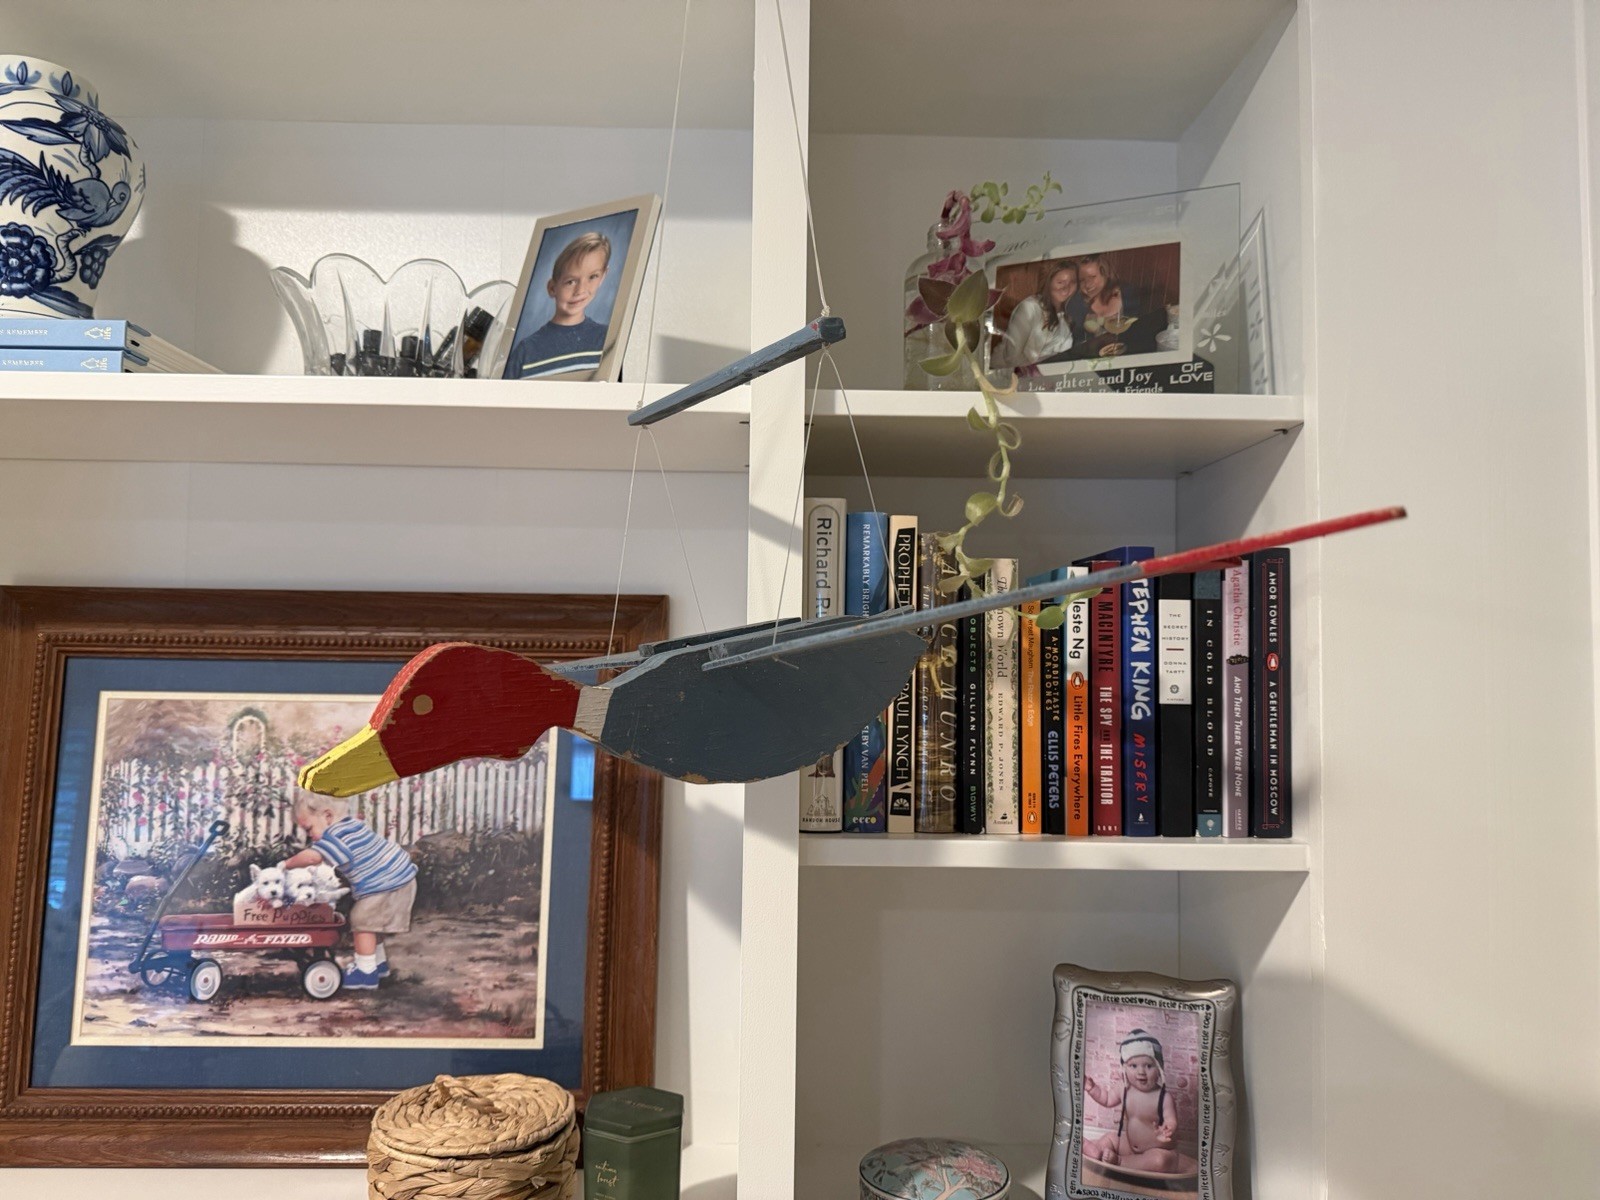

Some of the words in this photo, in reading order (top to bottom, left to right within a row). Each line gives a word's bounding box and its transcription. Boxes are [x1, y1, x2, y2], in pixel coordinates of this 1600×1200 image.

[1098, 369, 1124, 387] and
[1128, 368, 1153, 386] Joy
[1170, 372, 1213, 384] LOVE
[1181, 362, 1204, 373] OF
[815, 517, 832, 589] Richard
[862, 523, 871, 588] REMARKABLY
[1230, 568, 1243, 604] Agatha
[1268, 571, 1278, 600] AMOR
[862, 588, 870, 618] BRIGH
[1072, 601, 1085, 633] leste
[1128, 577, 1152, 653] TEPHEN
[1206, 609, 1213, 627] IN
[997, 607, 1005, 639] nown
[1027, 604, 1035, 636] Soerset
[1232, 606, 1244, 646] Christie
[1268, 604, 1278, 643] TOWLES
[969, 617, 977, 673] OBJECTS
[1068, 638, 1084, 659] Ng
[1098, 601, 1114, 672] MACINTYRE
[1026, 637, 1035, 669] Maugham
[1100, 686, 1112, 703] THE
[1130, 661, 1152, 721] KING
[1233, 675, 1242, 695] AND
[969, 683, 977, 731] GILLIAN
[1073, 695, 1084, 721] Little
[1100, 707, 1112, 726] SPY
[1233, 696, 1243, 718] THEN
[1268, 691, 1278, 750] GENTLEMAN
[861, 725, 870, 748] LBY
[940, 679, 957, 802] MUNRO
[1048, 730, 1059, 761] ELLIS
[1073, 725, 1083, 751] Fires
[1233, 719, 1243, 746] THERE
[861, 749, 869, 769] VAN
[895, 725, 910, 780] LYNCH
[969, 738, 977, 776] FLYNN
[1100, 744, 1113, 760] THE
[1234, 747, 1243, 771] WERE
[1269, 754, 1278, 765] IN
[861, 773, 869, 793] PELT
[1133, 733, 1149, 803] MISERY
[1048, 763, 1060, 809] PETERS
[1071, 754, 1084, 820] Everywhere
[1100, 765, 1114, 805] TRAITOR
[1234, 773, 1243, 797] NONE
[1269, 769, 1278, 816] MOSCOW
[243, 907, 268, 922] Free
[272, 907, 326, 925] Puppies
[261, 933, 312, 945] FLYER
[1089, 993, 1102, 1001] ten
[1102, 994, 1120, 1003] little
[1121, 995, 1139, 1004] toes
[1144, 999, 1157, 1007] ten
[1158, 999, 1176, 1009] little
